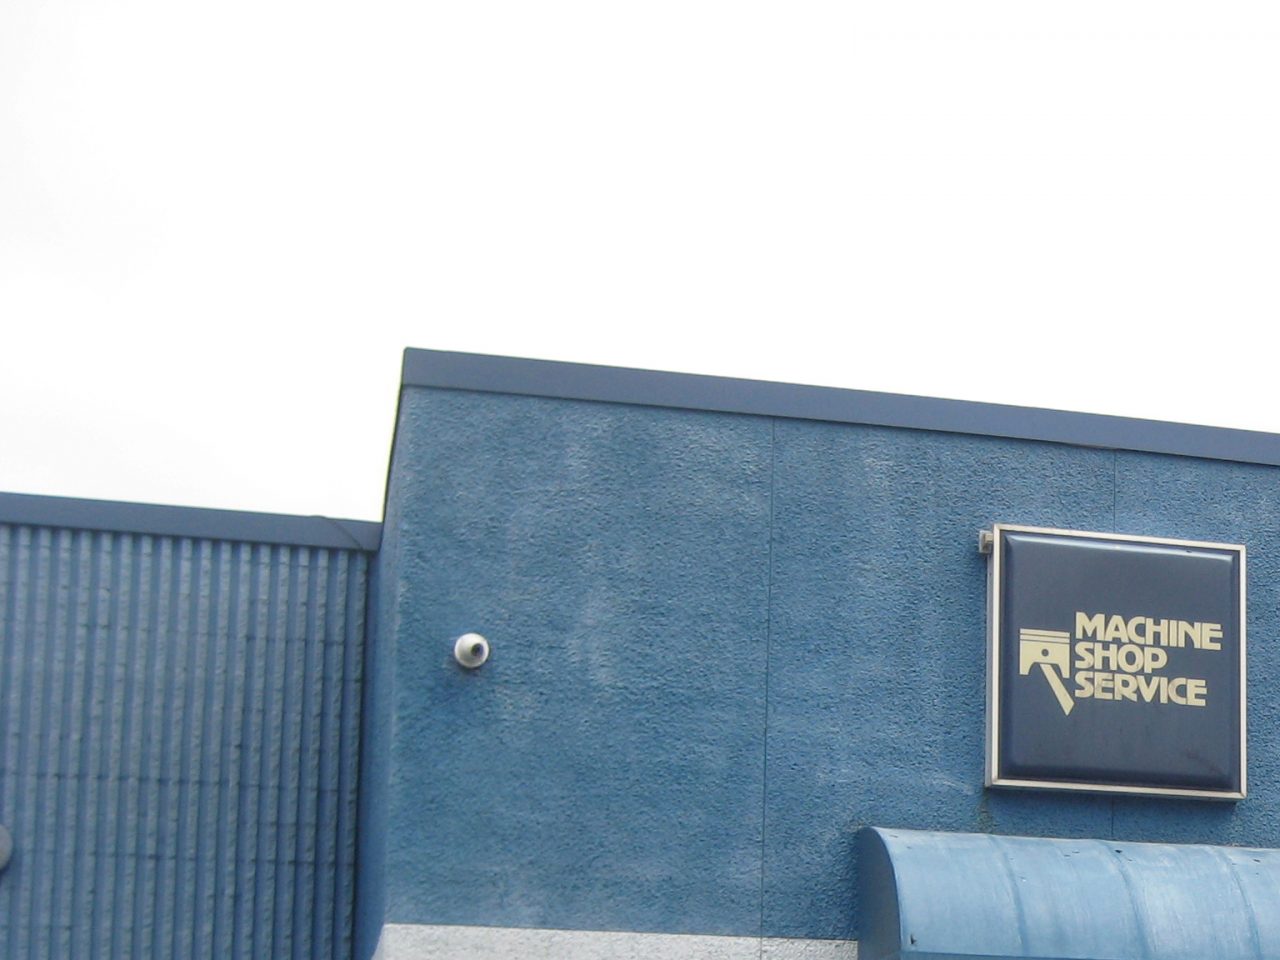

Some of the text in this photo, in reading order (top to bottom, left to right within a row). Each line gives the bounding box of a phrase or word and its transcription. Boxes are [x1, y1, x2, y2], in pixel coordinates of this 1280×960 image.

[1075, 611, 1223, 650] MACHINE
[1074, 641, 1168, 673] SHOP
[1074, 671, 1208, 706] SERVICE
